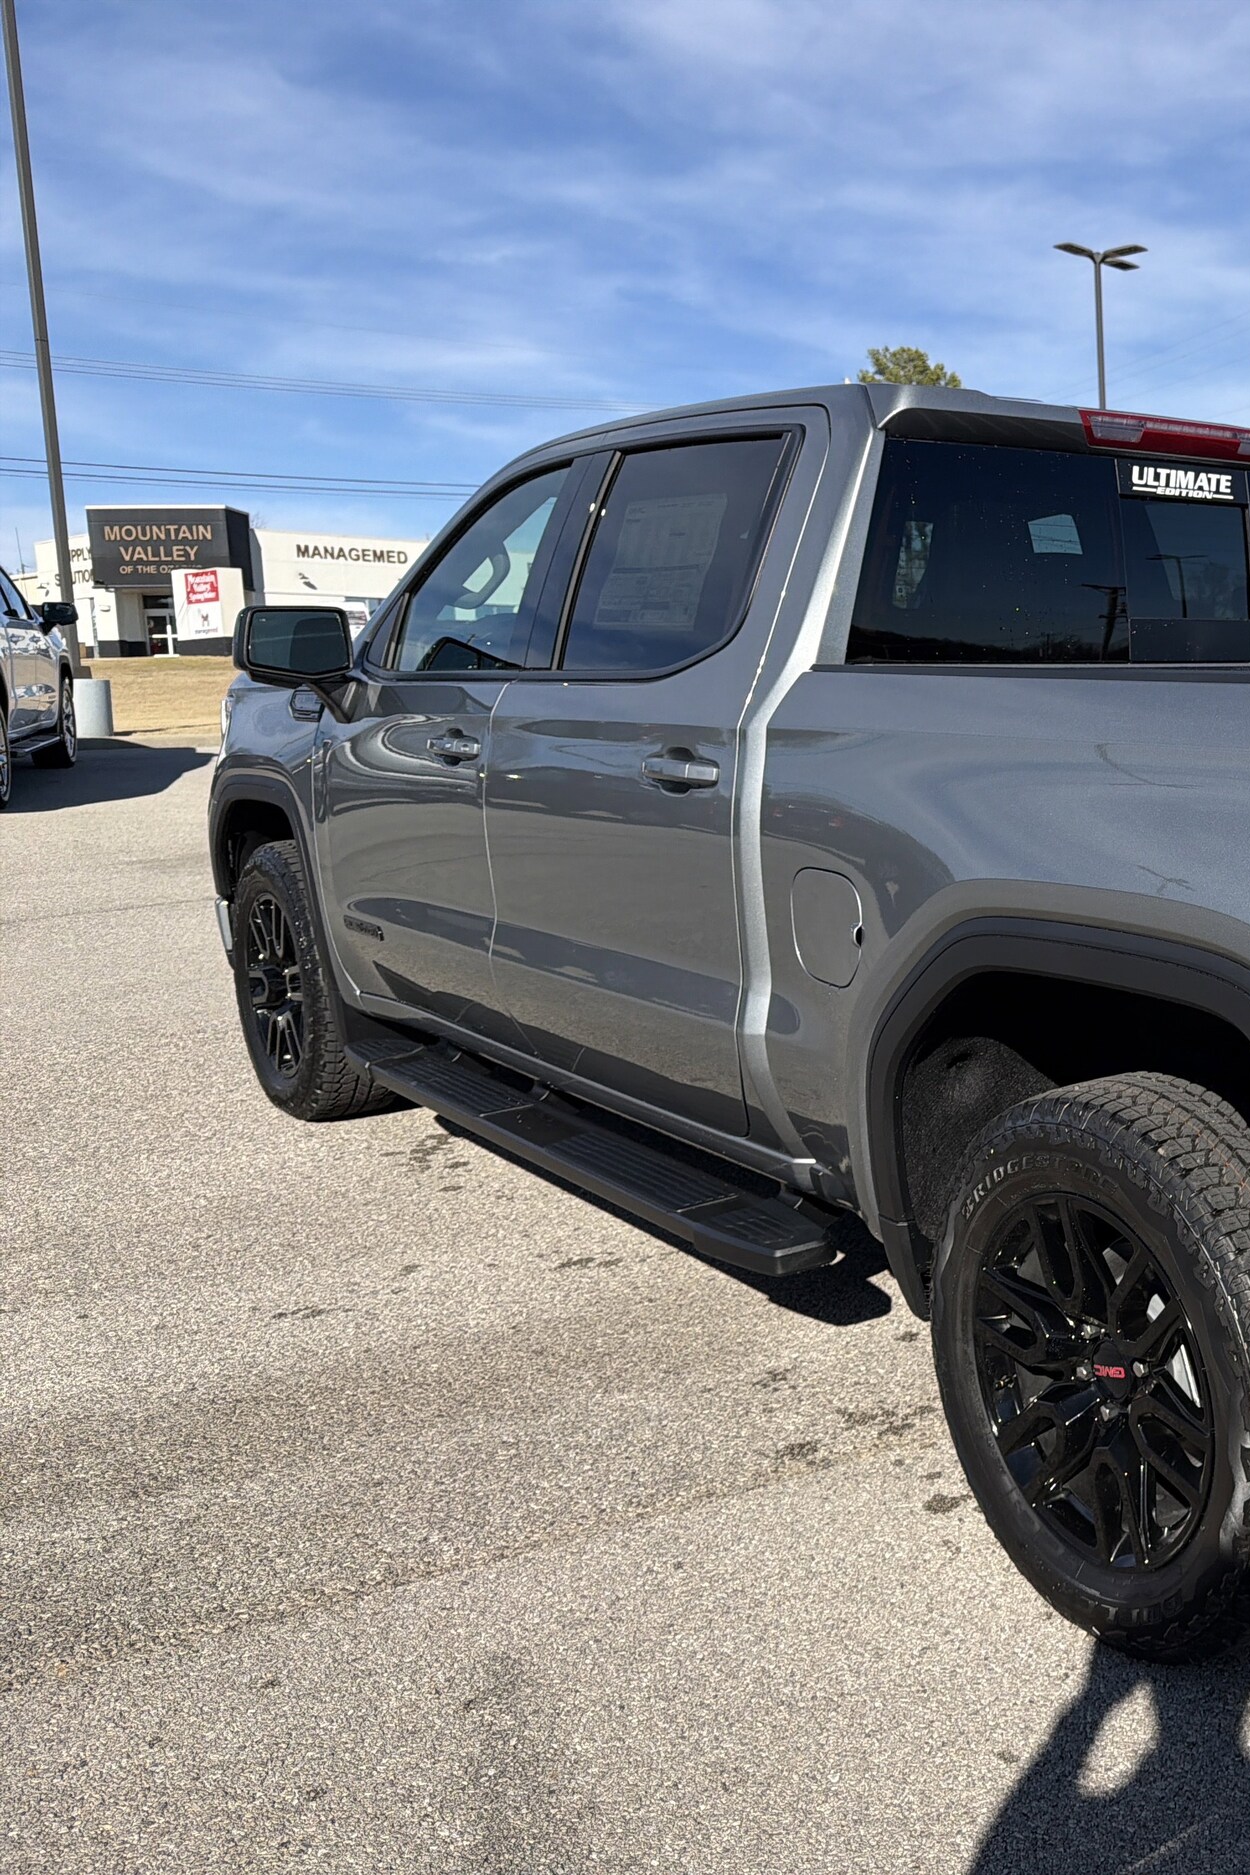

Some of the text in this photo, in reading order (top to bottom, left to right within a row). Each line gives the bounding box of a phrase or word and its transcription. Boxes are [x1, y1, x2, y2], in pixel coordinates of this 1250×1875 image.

[1131, 465, 1233, 493] ULTIMATE
[1156, 487, 1214, 500] EDITION
[103, 525, 212, 540] MOUNTAIN
[119, 545, 199, 561] VALLEY
[296, 544, 408, 564] MANAGEMED
[119, 565, 133, 574] OF
[136, 565, 157, 574] THE
[1093, 1364, 1126, 1379] GMC
